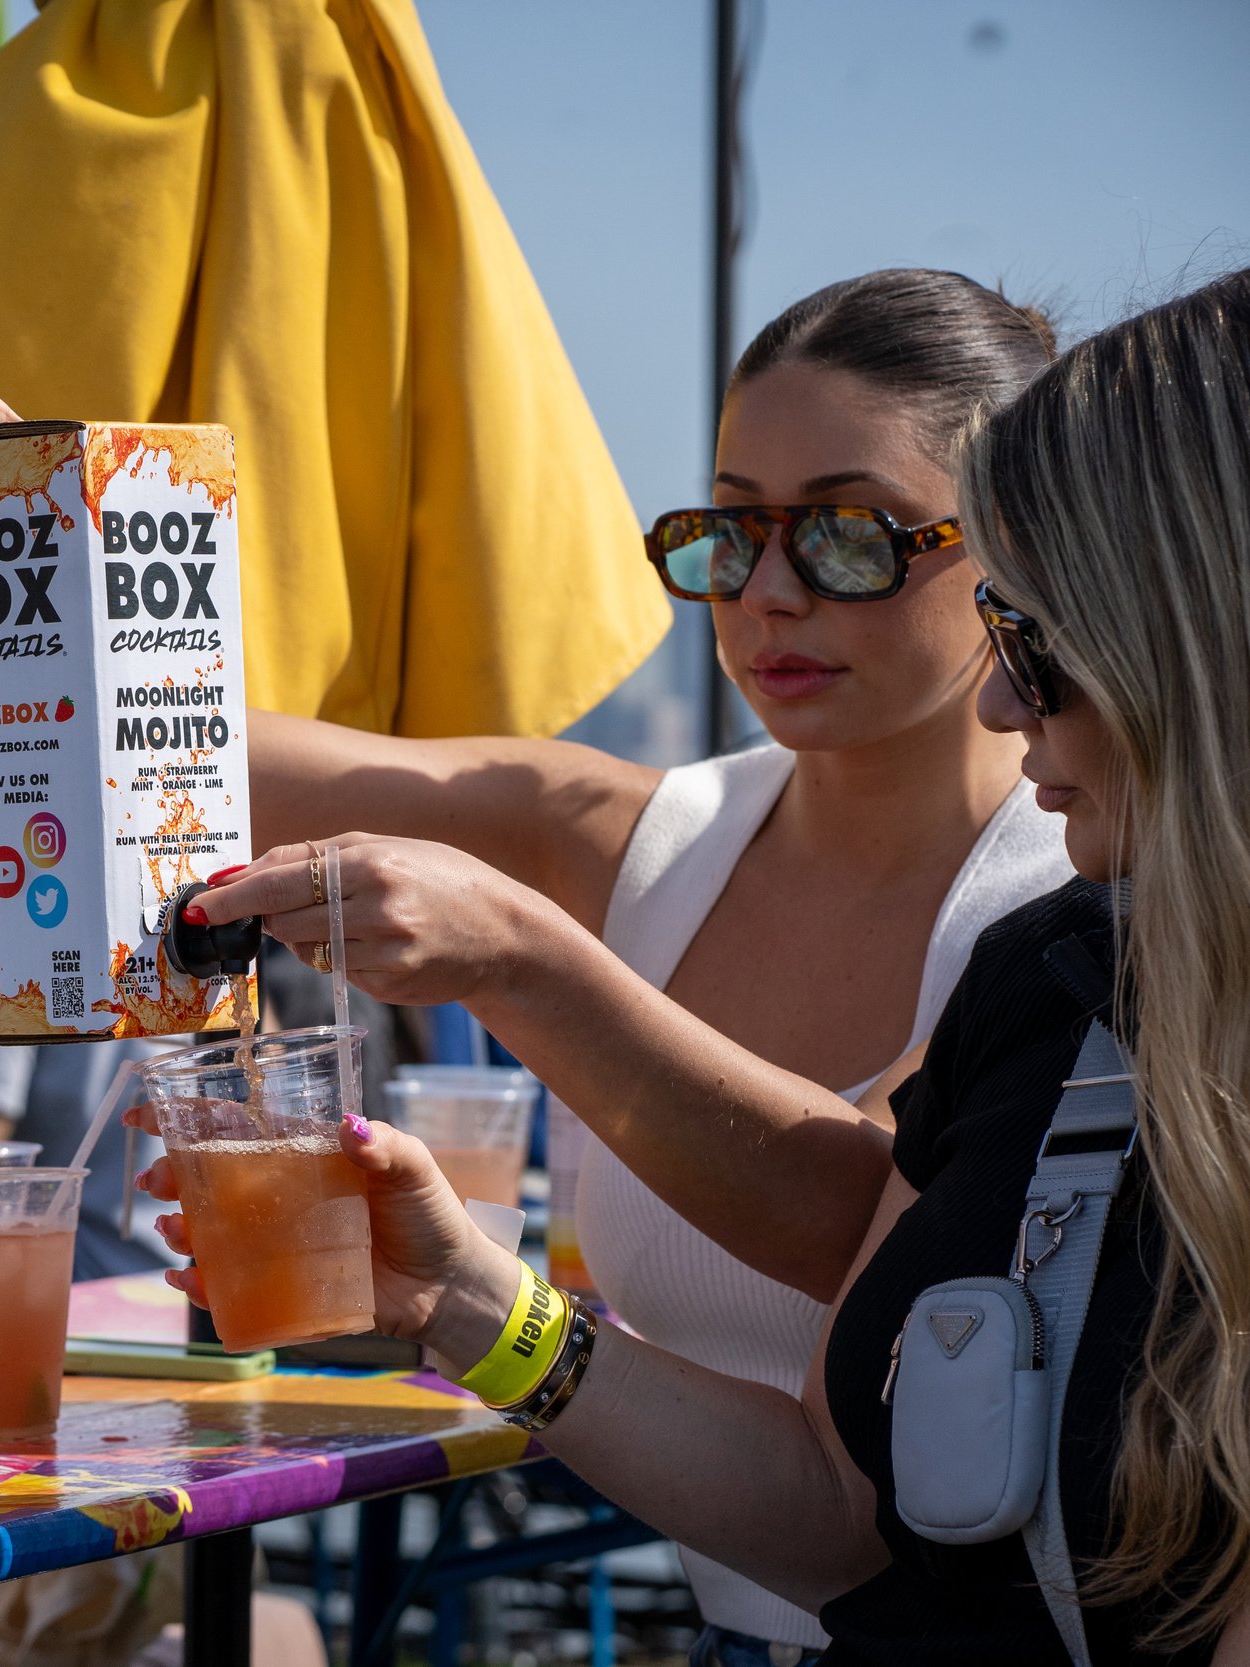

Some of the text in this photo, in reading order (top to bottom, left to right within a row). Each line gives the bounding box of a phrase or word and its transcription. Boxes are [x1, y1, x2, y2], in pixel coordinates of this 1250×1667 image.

[102, 511, 216, 555] BOOZ
[105, 562, 220, 620] BOX
[110, 627, 222, 653] COCKTAILS
[116, 686, 224, 708] MOONLIGHT
[116, 715, 229, 751] MOJITO
[138, 765, 218, 777] RUM STRAWBERRY
[10, 775, 25, 787] US
[30, 773, 49, 785] ON
[131, 778, 223, 791] MINT ORANGE LIME
[4, 791, 49, 804] MEDIA:
[116, 832, 238, 846] RUM WITH REAL FRUIT JUICE AND
[148, 845, 218, 856] NATURAL FLAVORS.
[52, 950, 80, 961] SCAN
[53, 962, 80, 973] HERE
[125, 957, 155, 974] 21+
[118, 975, 160, 985] ALC. 12.5%
[125, 985, 153, 995] BY VOL.
